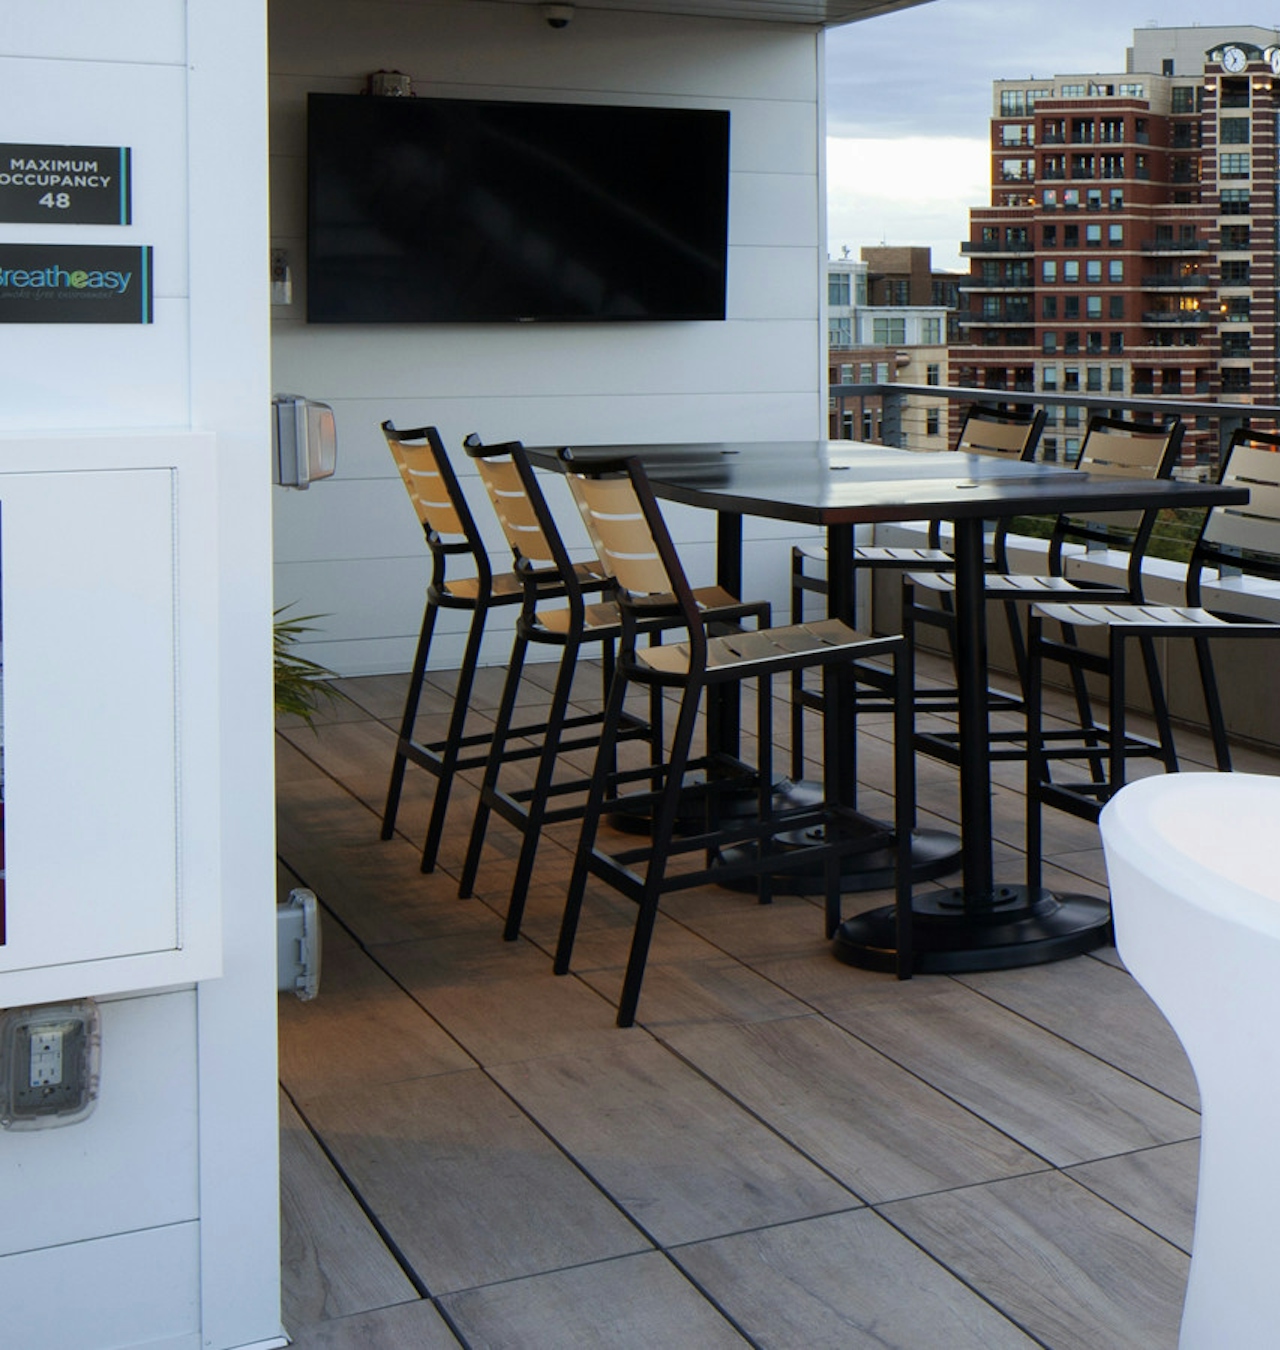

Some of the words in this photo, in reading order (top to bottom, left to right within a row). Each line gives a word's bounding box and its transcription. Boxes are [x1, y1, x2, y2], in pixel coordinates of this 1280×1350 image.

[10, 158, 99, 173] MAXIMUM
[0, 173, 111, 188] OCCUPANCY
[38, 192, 71, 209] 48
